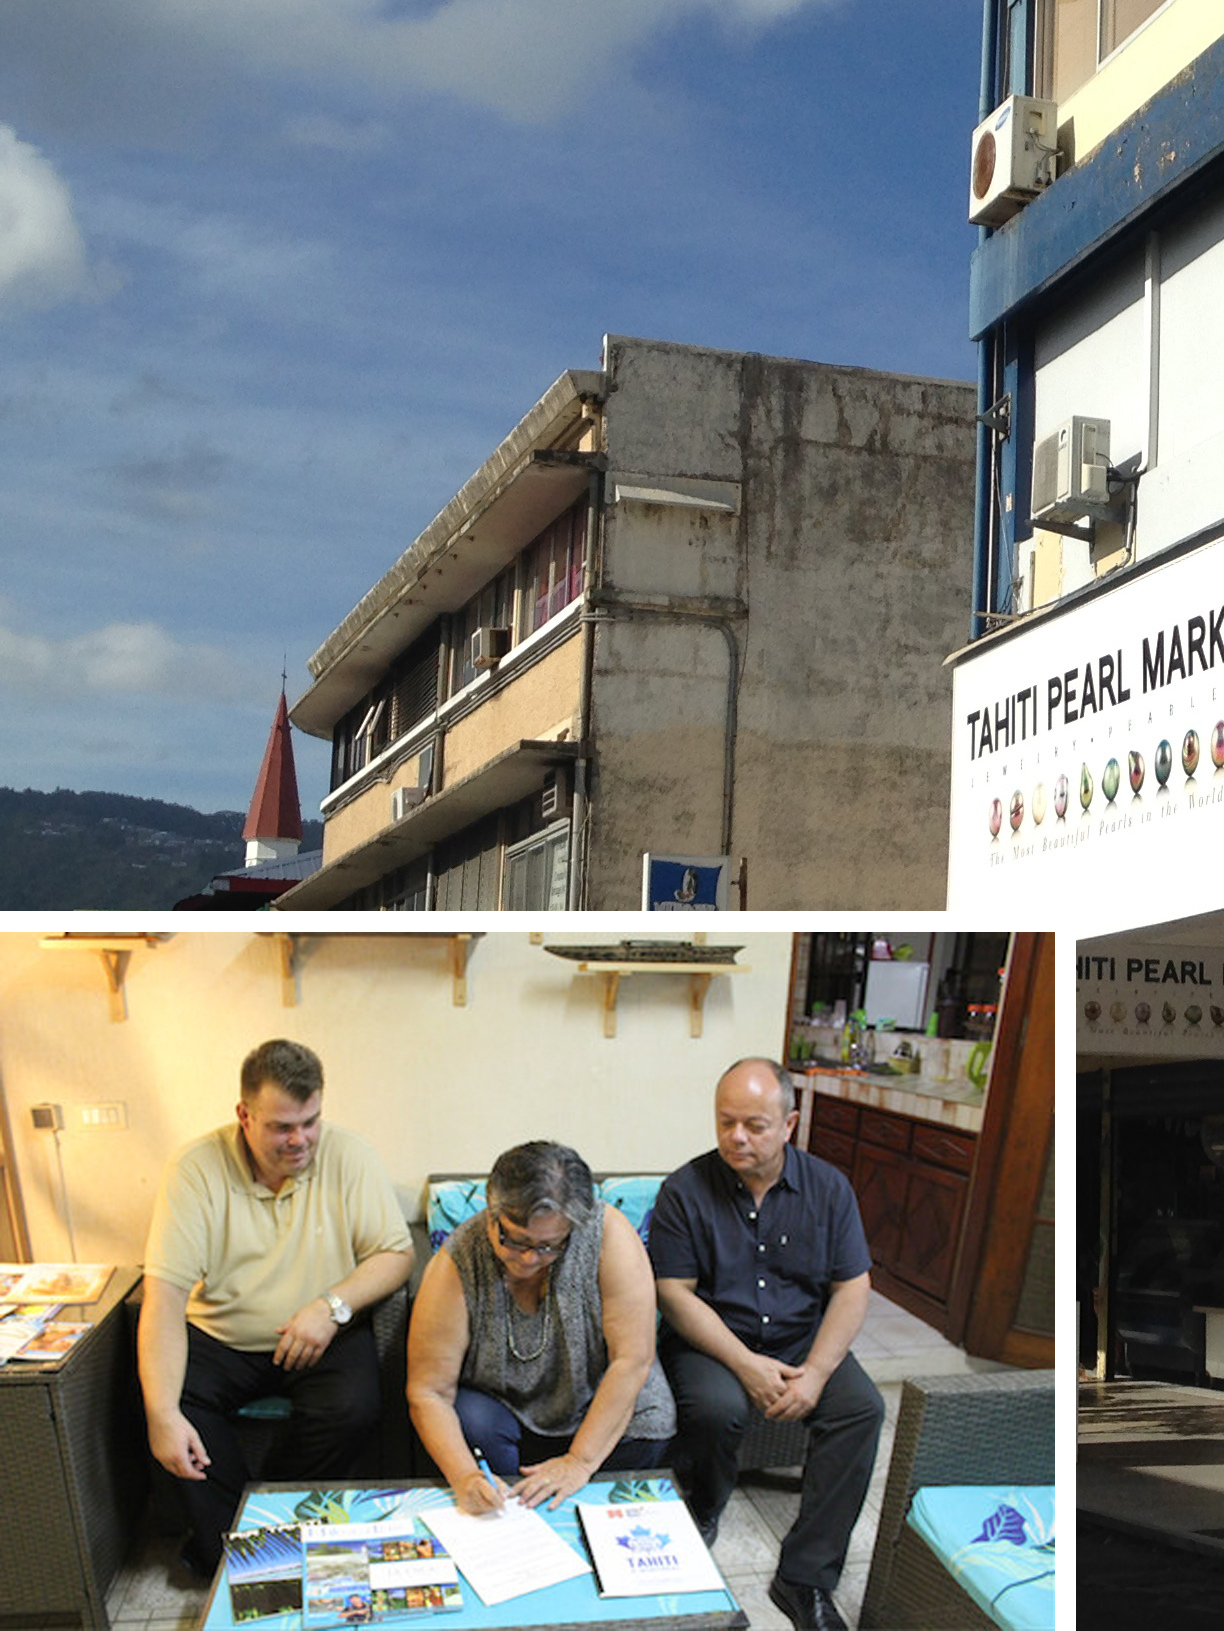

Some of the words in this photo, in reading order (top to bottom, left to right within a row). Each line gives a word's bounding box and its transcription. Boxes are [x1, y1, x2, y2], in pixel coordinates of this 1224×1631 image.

[967, 685, 1037, 761] TAHITI
[1048, 649, 1131, 731] PEARL
[989, 852, 1005, 868] The
[1013, 842, 1035, 860] Most
[1042, 824, 1091, 850] Beautiful
[1099, 813, 1133, 836] Pearls
[1141, 811, 1152, 823] in
[1161, 799, 1179, 818] the
[1189, 785, 1224, 810] World
[1127, 958, 1212, 986] PEARL
[627, 1555, 679, 1568] TAHITI
